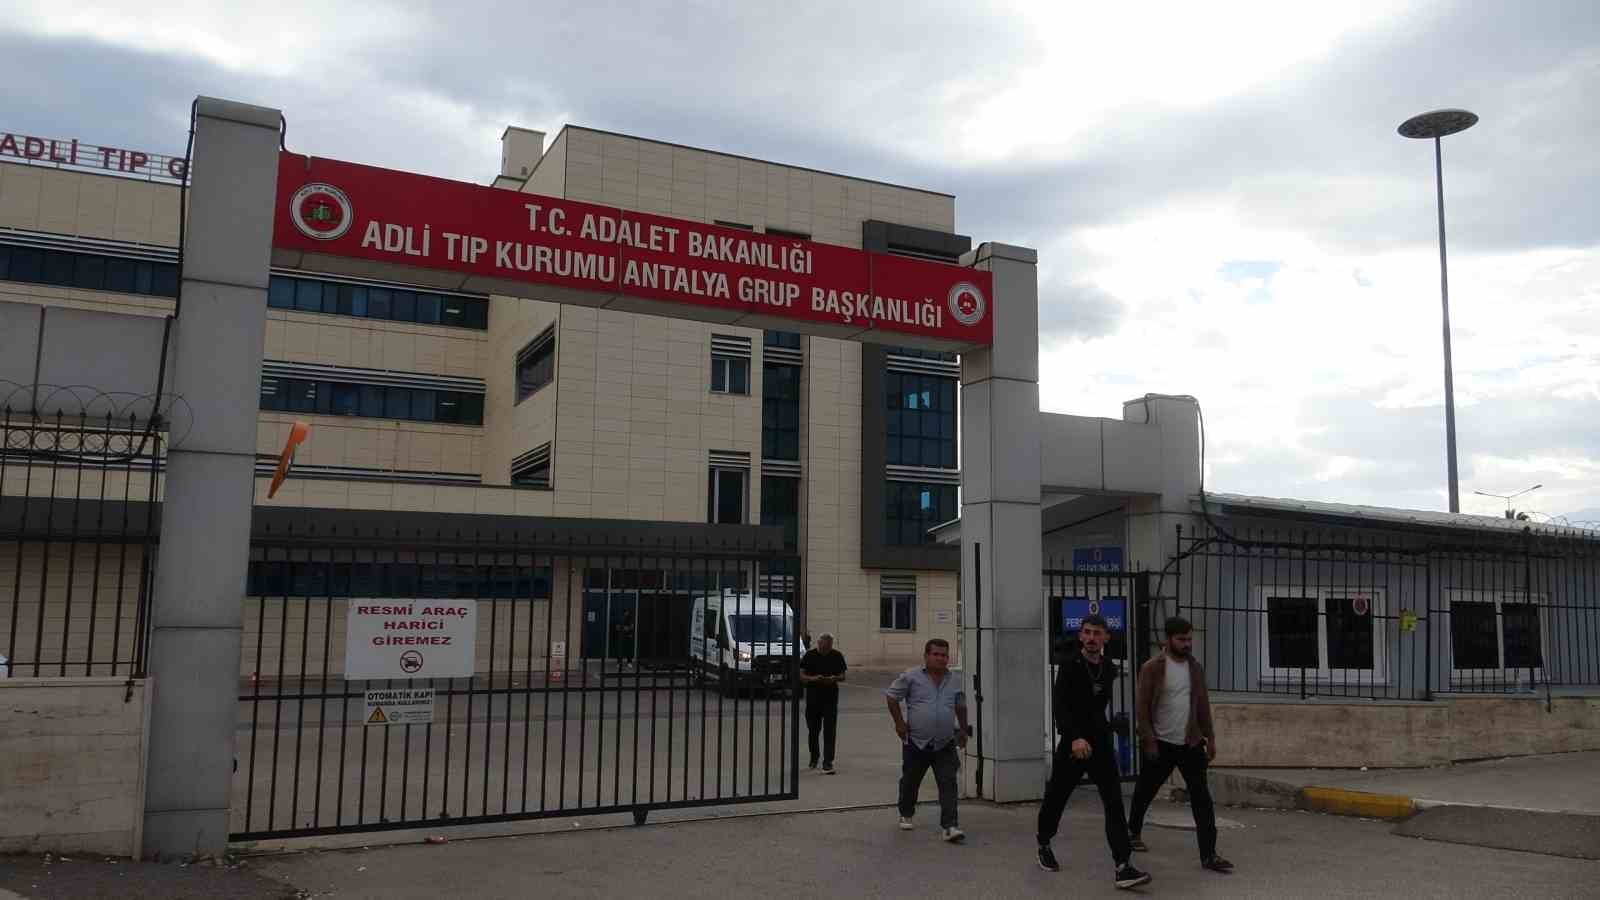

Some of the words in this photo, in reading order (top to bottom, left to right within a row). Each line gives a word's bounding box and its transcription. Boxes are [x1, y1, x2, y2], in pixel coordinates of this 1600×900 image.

[0, 133, 78, 164] ADLİ
[98, 146, 148, 172] TIP
[525, 203, 572, 236] T.C.
[580, 213, 680, 253] ADALET
[688, 230, 813, 275] BAKANLIĞI
[361, 220, 431, 257] ADLİ
[442, 231, 488, 263] TIP
[495, 240, 616, 282] KURUMU
[624, 260, 730, 298] ANTALYA
[738, 276, 801, 308] GRUP
[811, 286, 943, 329] BAŞKANLIĞI
[357, 603, 412, 615] RESMİ
[421, 607, 468, 619] ARAÇ
[372, 634, 452, 646] GİREMEZ
[367, 690, 412, 701] OTOMATİK
